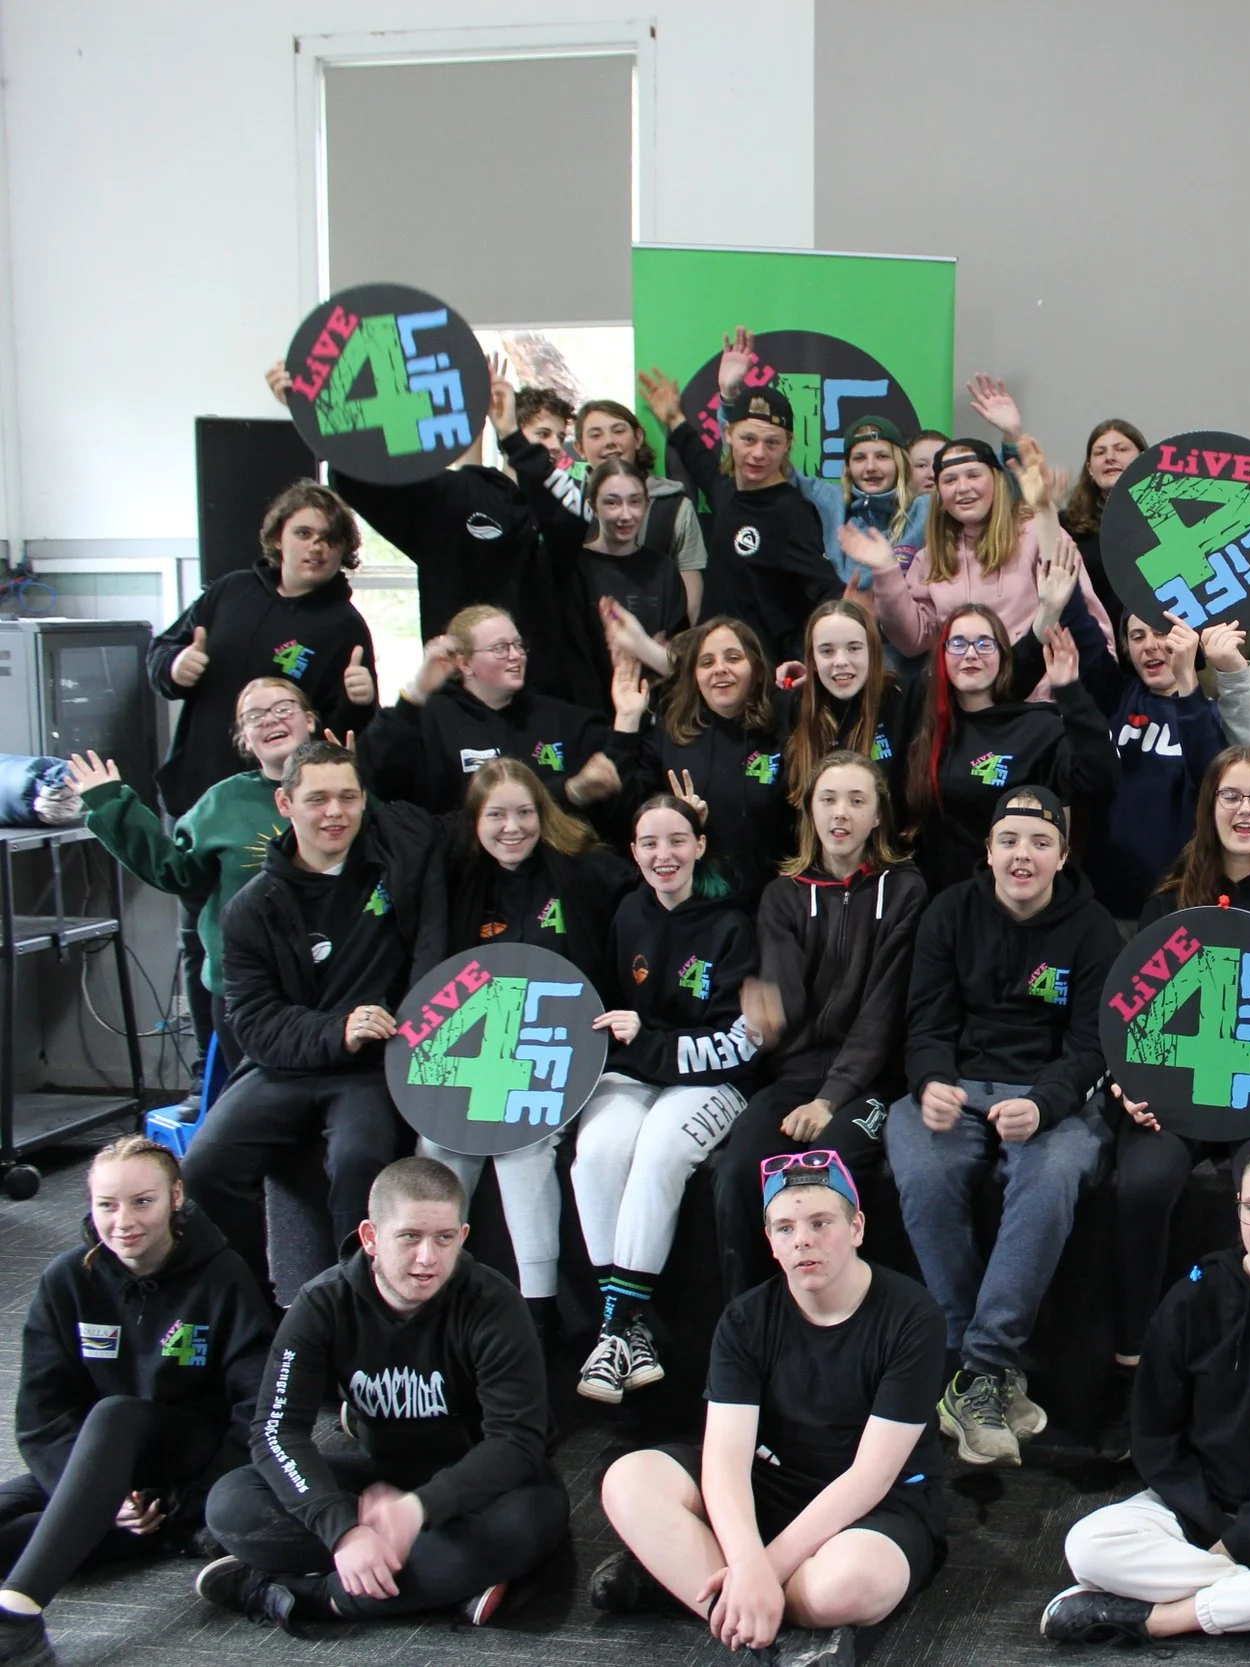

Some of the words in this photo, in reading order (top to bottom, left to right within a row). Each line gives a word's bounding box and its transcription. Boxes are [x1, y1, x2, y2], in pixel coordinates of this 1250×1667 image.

[293, 306, 359, 399] LiVE
[315, 313, 433, 456] 4
[396, 308, 471, 452] LiFE
[272, 644, 305, 675] 4
[1118, 714, 1182, 756] FIL
[537, 744, 565, 772] 4
[745, 754, 773, 785] 4
[971, 755, 1003, 785] 4
[540, 898, 566, 934] 4
[679, 959, 705, 998] 4
[1029, 967, 1058, 1003] 4
[1108, 927, 1201, 1023] LiVE
[397, 960, 494, 1048] LiVE
[406, 977, 534, 1123] 4
[504, 981, 583, 1126] LiFE
[161, 1323, 197, 1366] 4
